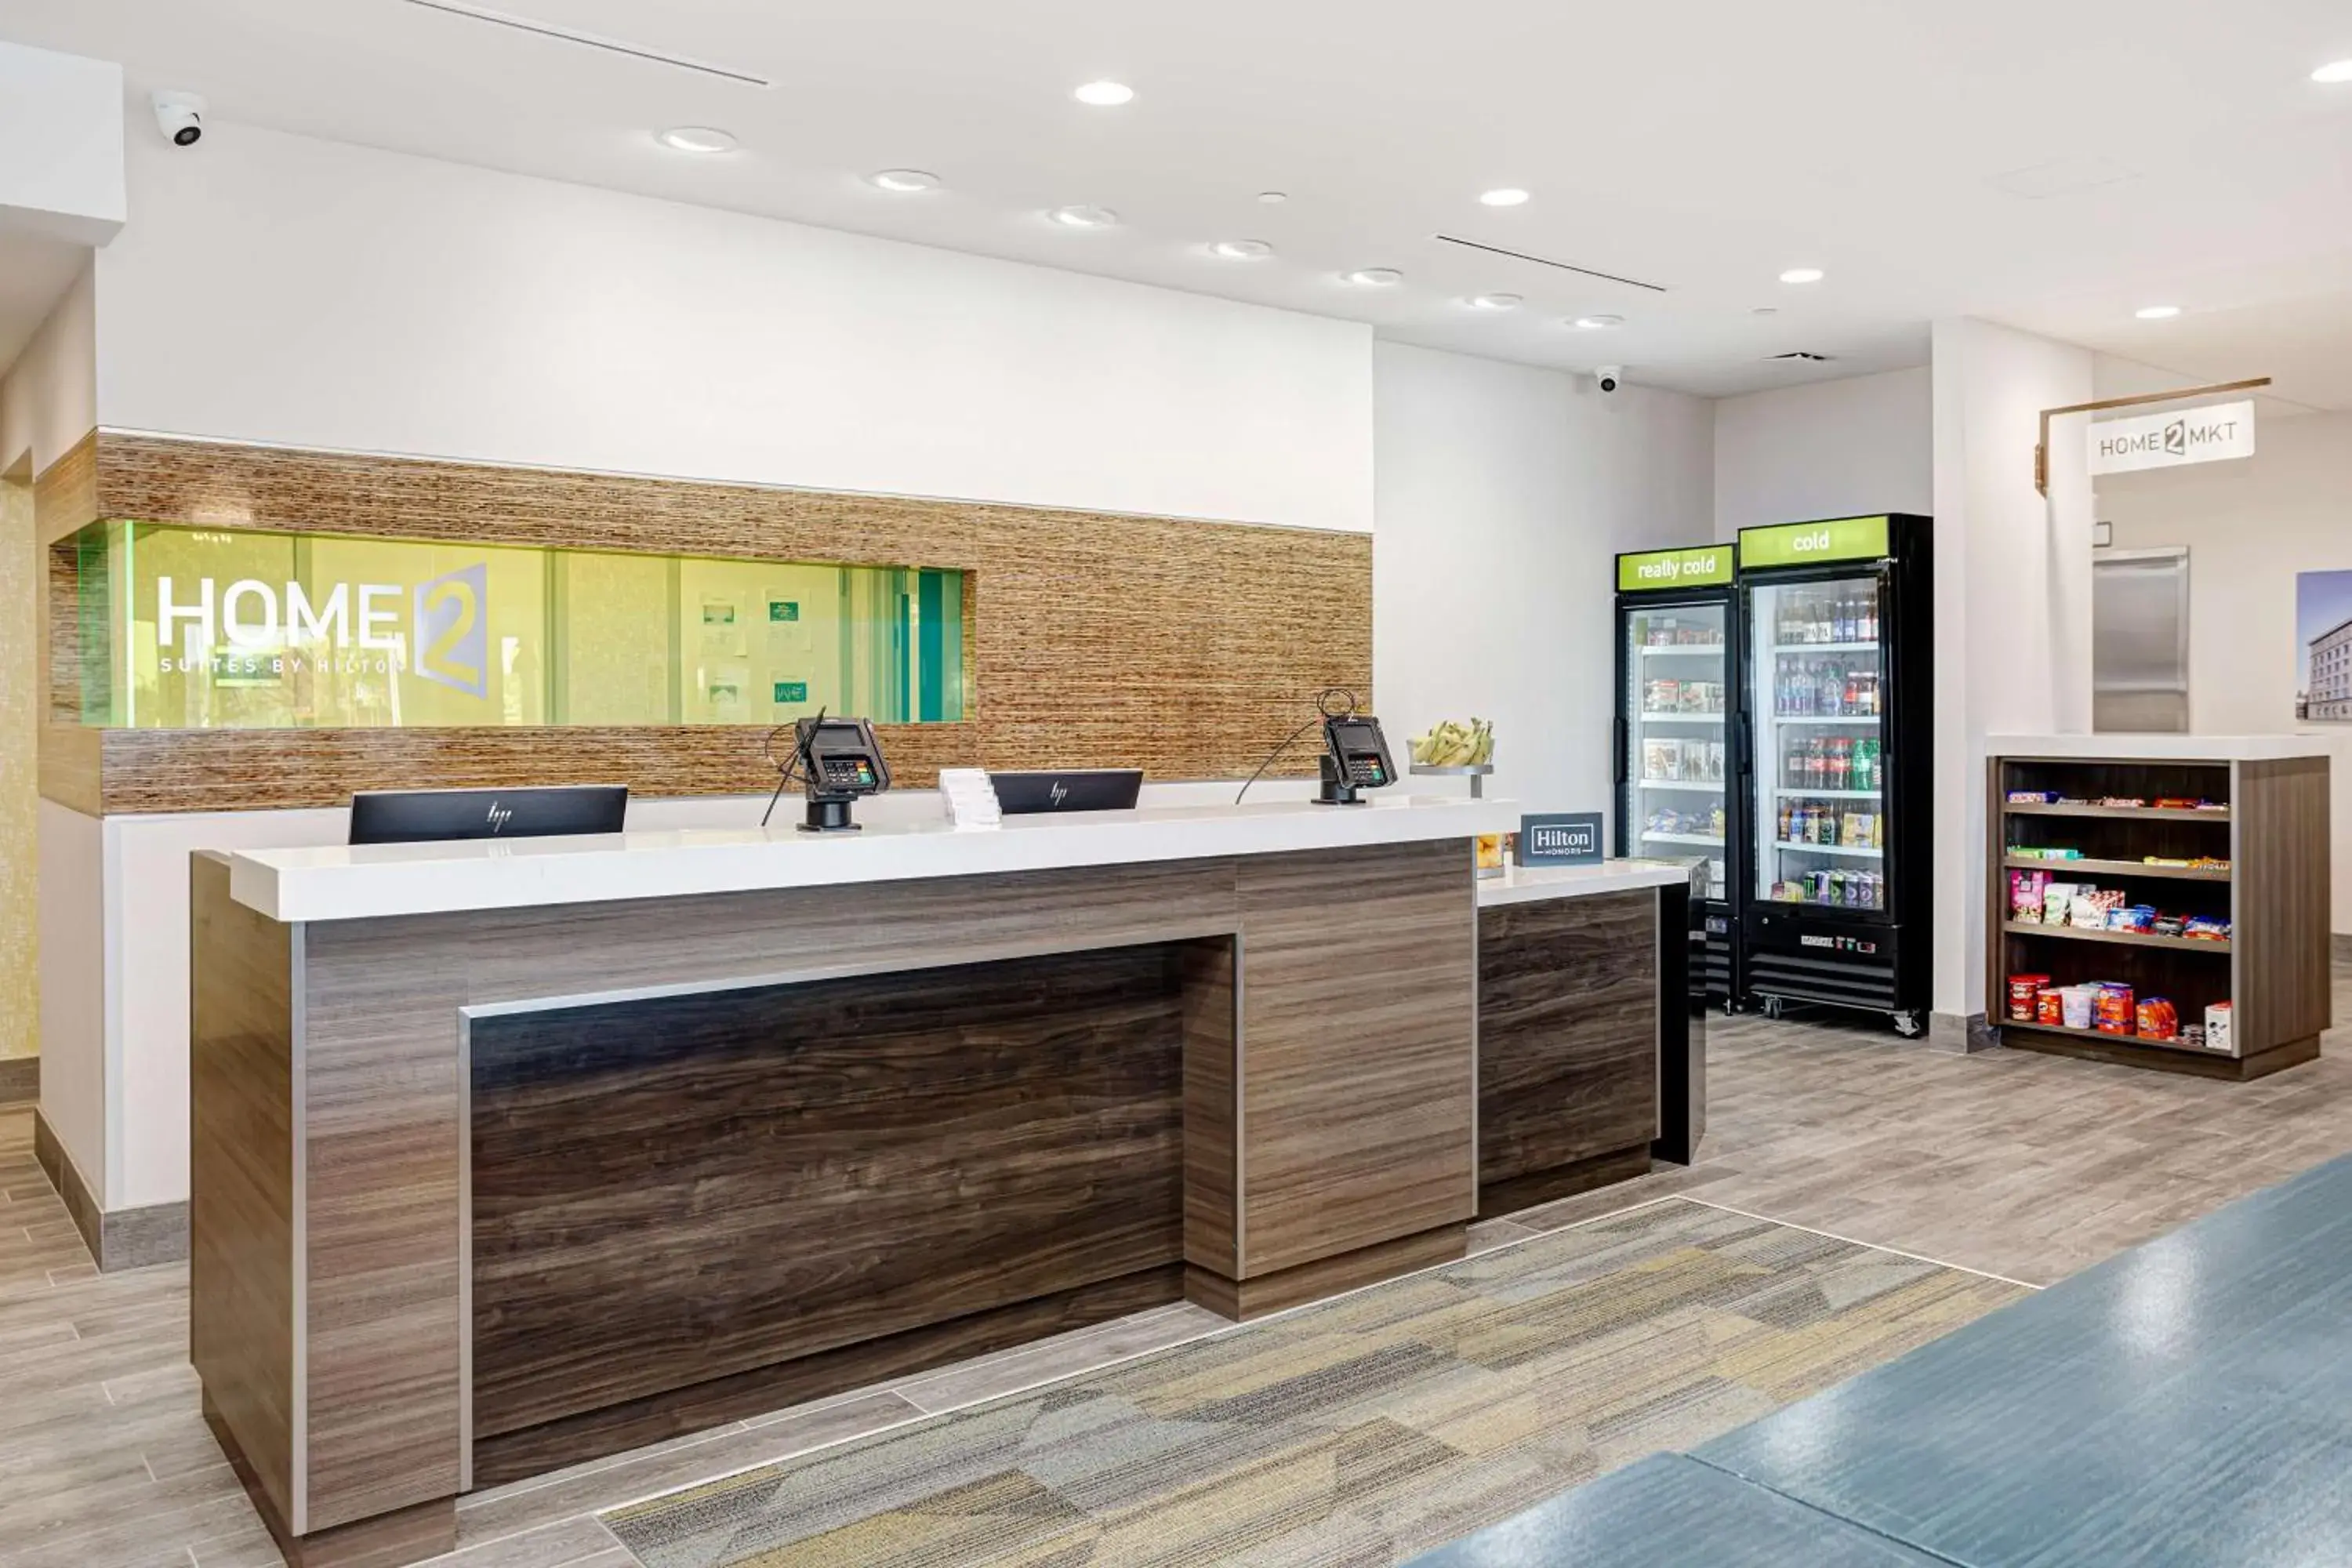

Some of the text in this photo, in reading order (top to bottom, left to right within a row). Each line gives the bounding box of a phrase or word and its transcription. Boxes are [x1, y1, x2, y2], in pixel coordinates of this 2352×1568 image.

[2100, 433, 2160, 457] HOME
[2190, 422, 2238, 445] MKT
[1793, 530, 1830, 551] cold
[1638, 556, 1715, 580] really cold
[157, 575, 403, 649] HOME
[159, 658, 257, 673] SUITES
[272, 658, 303, 673] BY
[1537, 830, 1589, 846] Hilton
